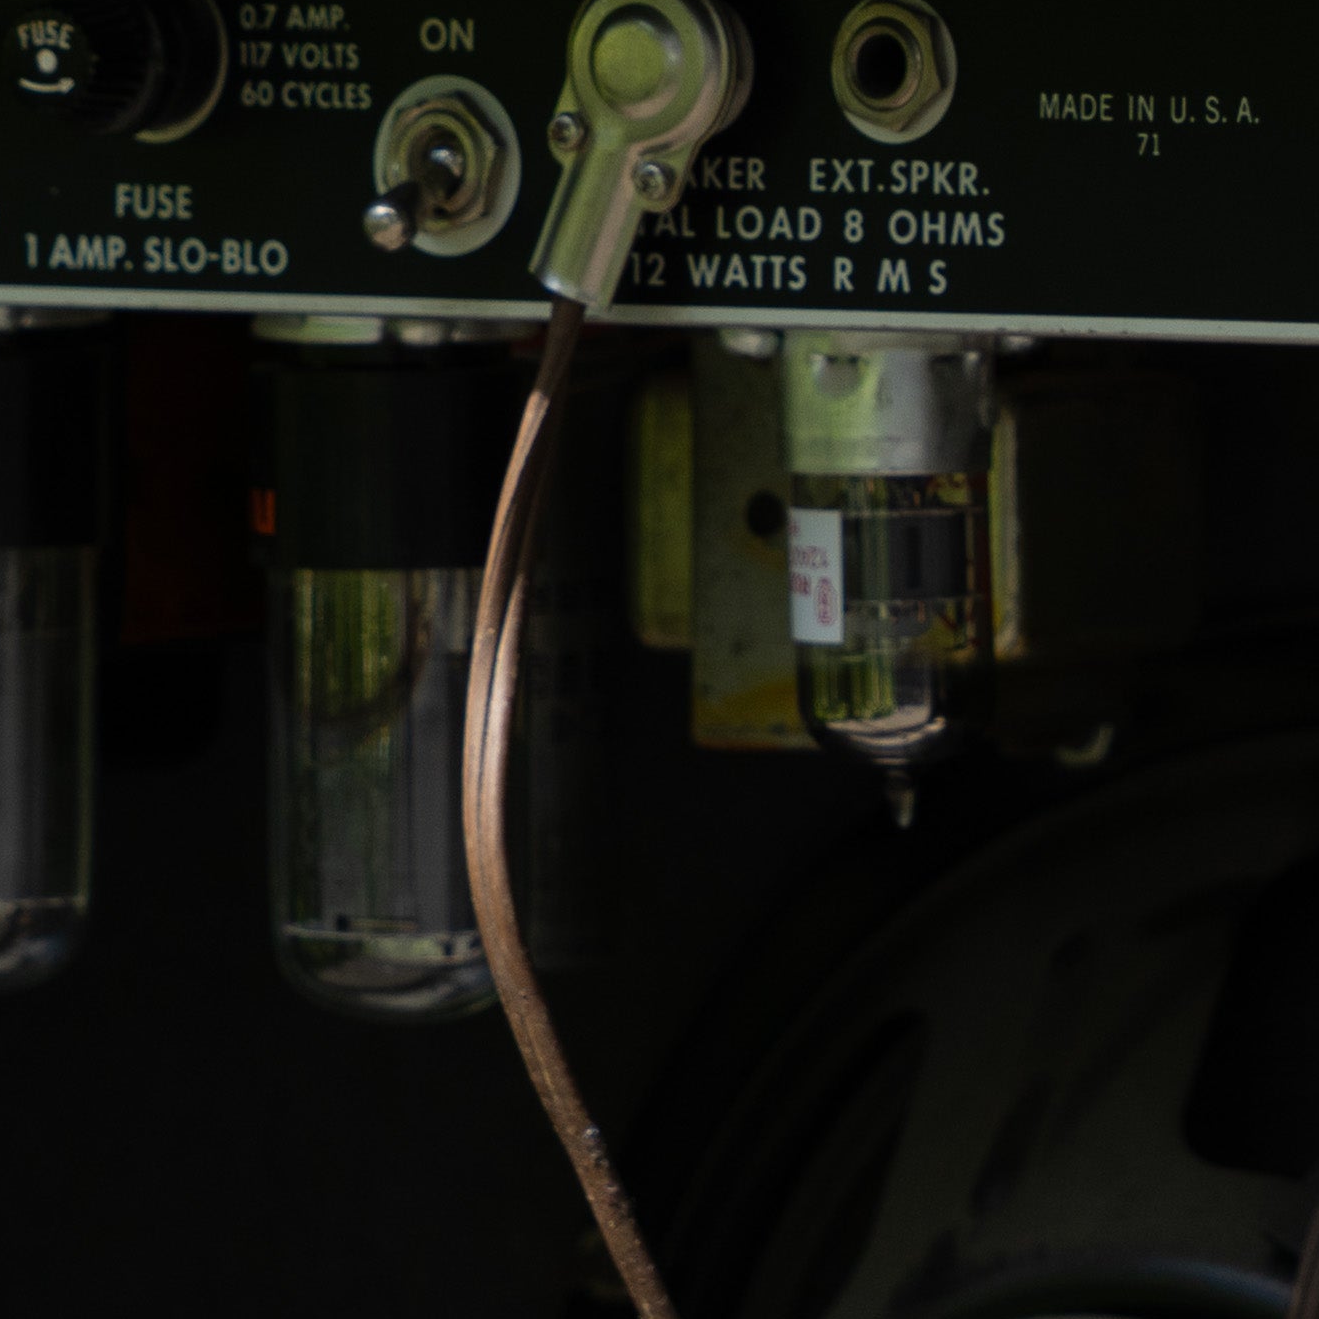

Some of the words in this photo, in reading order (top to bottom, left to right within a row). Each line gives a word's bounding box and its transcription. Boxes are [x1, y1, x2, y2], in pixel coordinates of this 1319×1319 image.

[239, 3, 278, 30] 0.7
[285, 4, 350, 31] AMP.
[16, 19, 75, 51] FUSE
[419, 17, 475, 52] ON
[239, 41, 273, 68] 117
[282, 42, 360, 71] VOLTS
[240, 80, 275, 107] 60
[281, 81, 373, 110] CYCLES
[1039, 92, 1114, 122] MADE
[1128, 94, 1155, 122] IN
[1137, 132, 1161, 157] 71
[115, 183, 192, 220] FUSE
[717, 205, 822, 242] LOAD
[843, 208, 864, 244] 8
[888, 208, 1006, 247] OHMS
[24, 232, 38, 268] 1
[49, 234, 134, 271] AMP.
[144, 236, 289, 276] SLO-BLO
[630, 252, 667, 287] 12
[688, 253, 807, 291] WATTS
